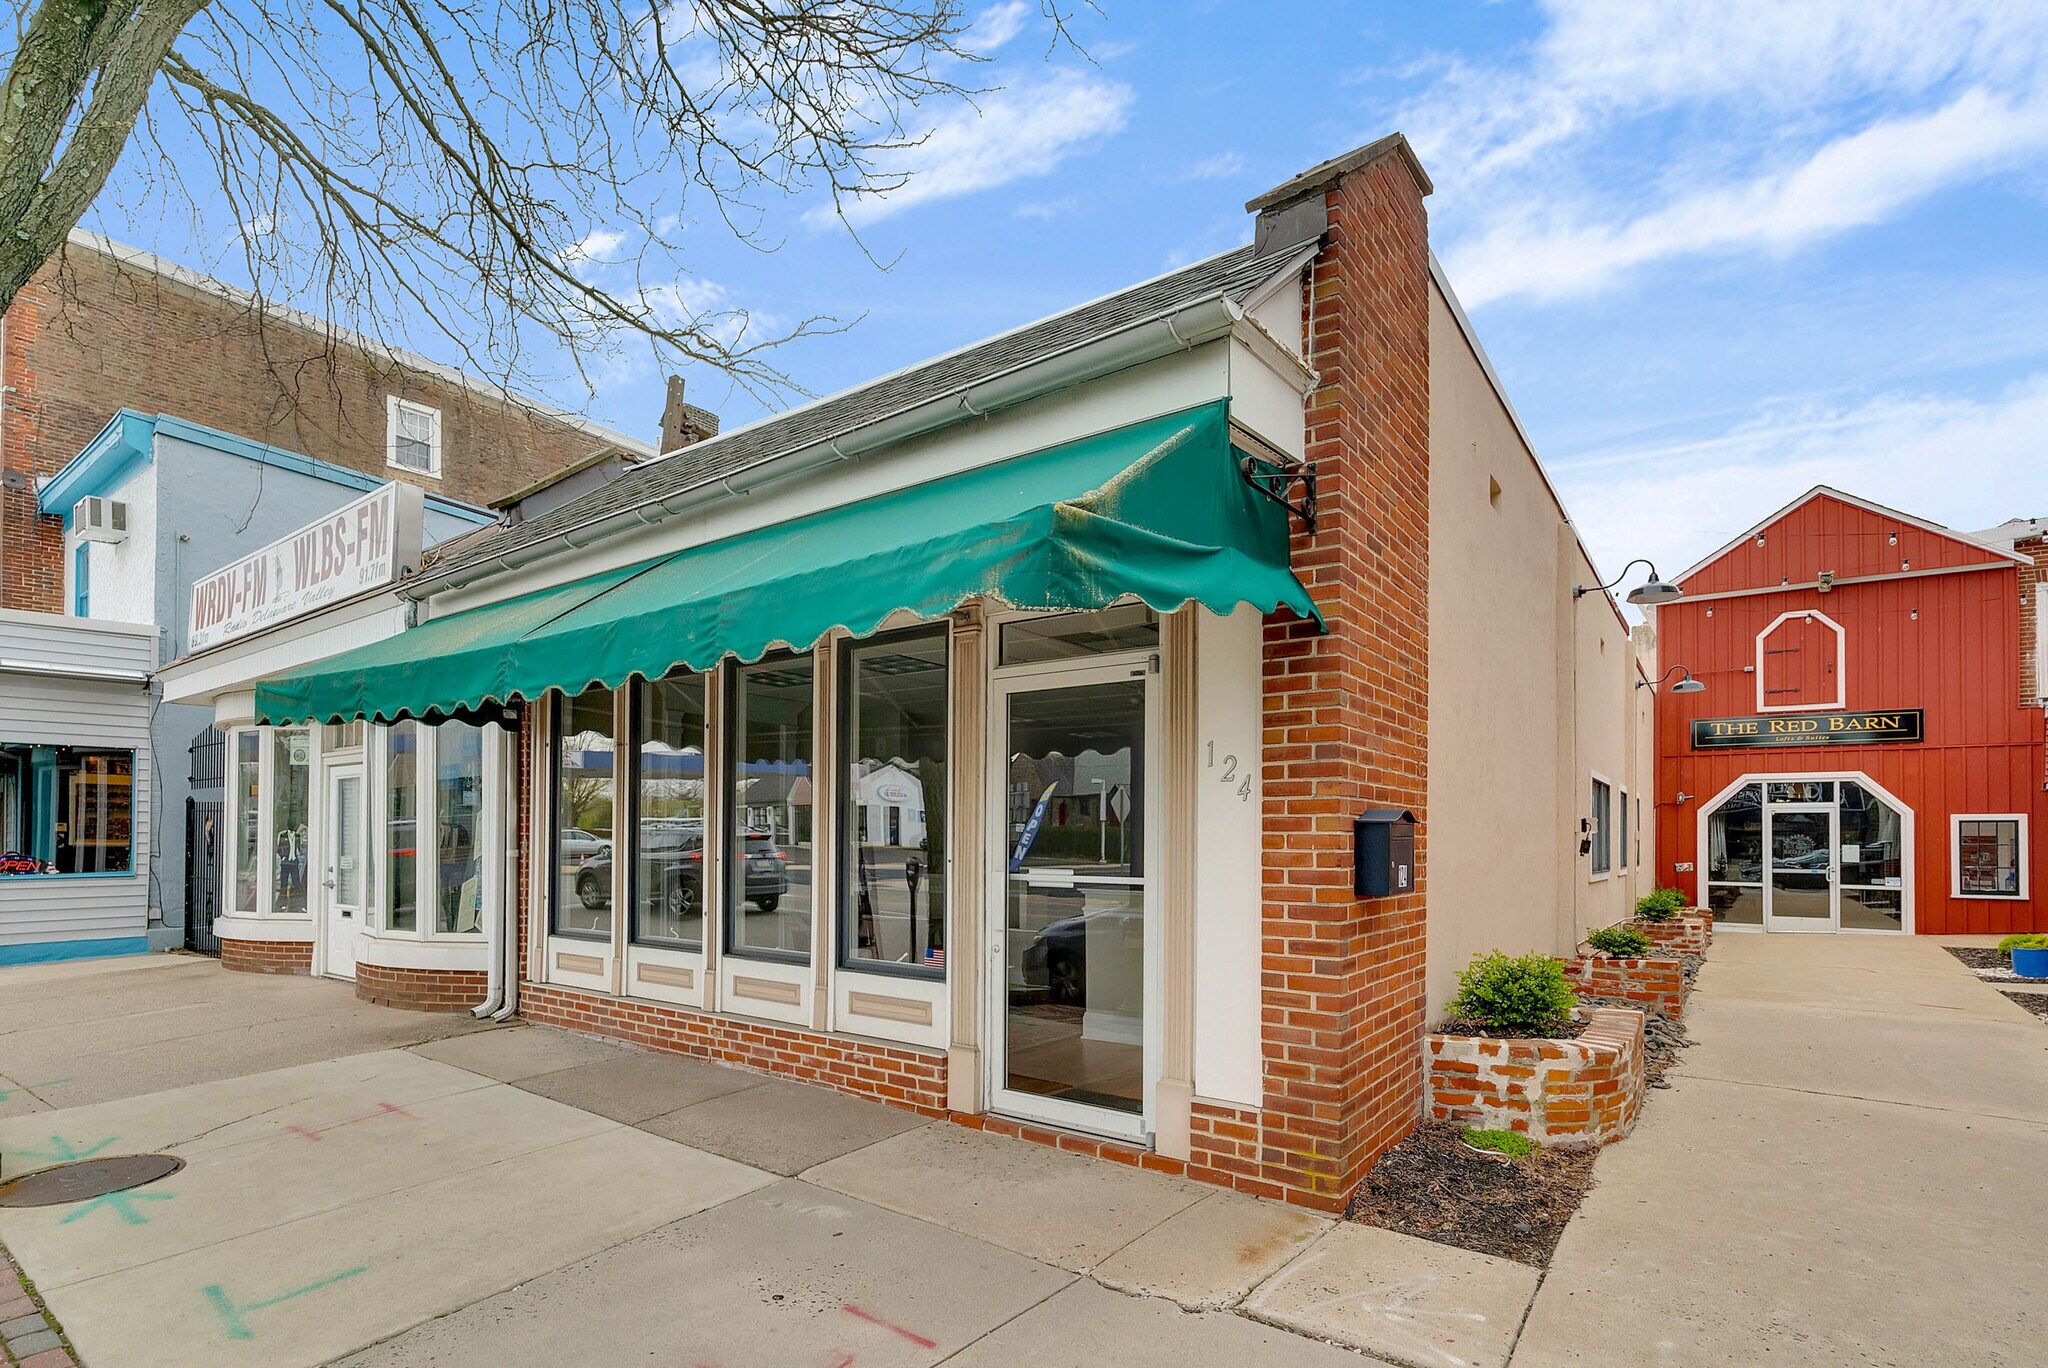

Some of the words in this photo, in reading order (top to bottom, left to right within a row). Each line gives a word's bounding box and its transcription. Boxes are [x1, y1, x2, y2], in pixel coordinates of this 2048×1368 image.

[293, 494, 389, 595] WLBS-FM
[359, 561, 386, 585] 91.7fm
[195, 554, 267, 632] WRDV-FM
[222, 619, 248, 637] Radio
[252, 602, 297, 625] Delaware
[301, 586, 335, 606] Valley
[1710, 722, 1758, 736] THE
[1768, 719, 1818, 733] RED
[1828, 716, 1901, 732] BARN
[1206, 740, 1252, 802] 124
[1014, 804, 1043, 861] OPEN
